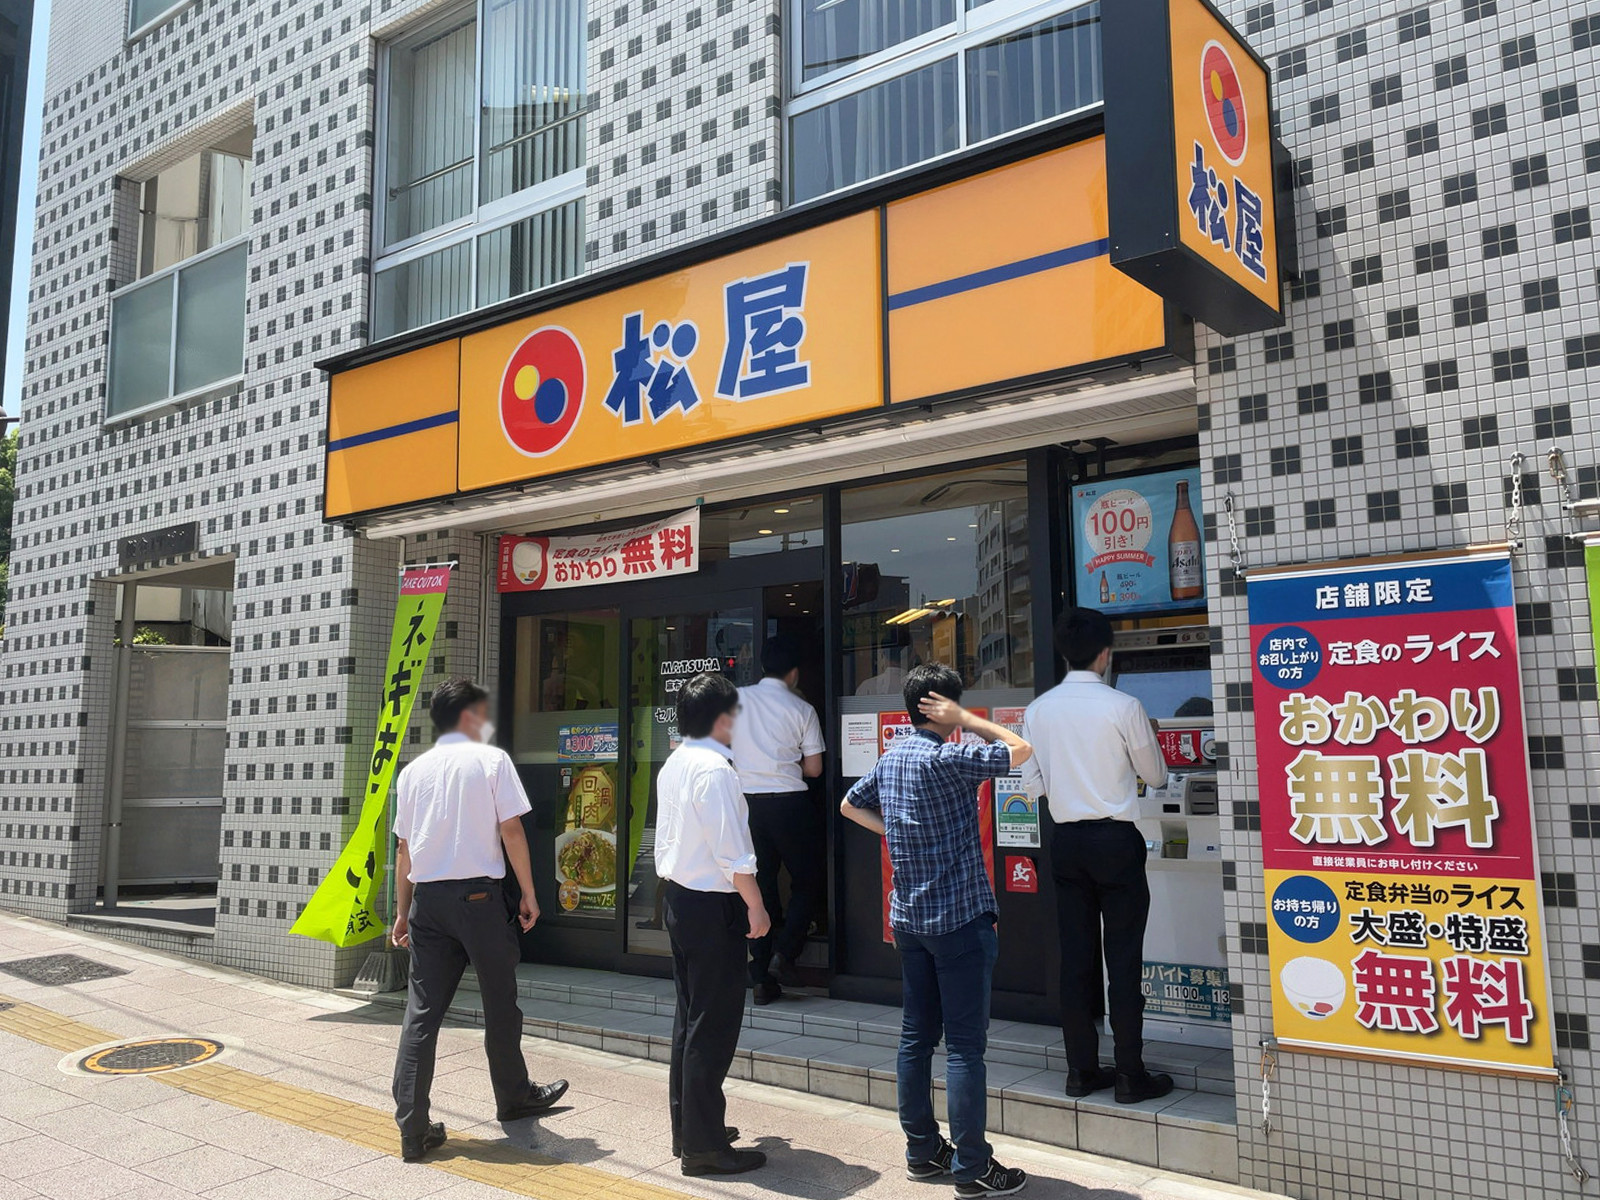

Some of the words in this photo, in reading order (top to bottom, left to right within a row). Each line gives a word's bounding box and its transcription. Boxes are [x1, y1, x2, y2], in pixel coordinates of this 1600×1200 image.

[1187, 139, 1267, 284] 松屋
[601, 260, 812, 428] 松屋
[1090, 508, 1149, 536] 100円
[552, 542, 620, 560] 定食のライス
[553, 556, 618, 583] おかわり
[620, 525, 694, 575] 無料
[1095, 555, 1116, 565] HAPPY
[1116, 553, 1145, 561] SUMMER
[1316, 578, 1433, 610] 店舗限定
[1269, 637, 1308, 651] 店内で
[1327, 631, 1501, 666] 定食のライス
[1259, 651, 1319, 667] お召し上がり
[1278, 666, 1302, 680] の方
[665, 678, 686, 692] 麻布
[655, 707, 677, 723] セル
[1279, 687, 1499, 745] おかわり
[667, 726, 680, 735] SEL
[571, 735, 594, 752] 300
[1285, 748, 1499, 848] 無料
[1312, 855, 1479, 872] 直接従業員にお申し付けください
[1344, 880, 1525, 911] 定食弁当のライス
[1273, 897, 1337, 914] お持ち帰り
[1294, 915, 1319, 929] の方
[1349, 907, 1529, 955] 大盛・特盛
[1352, 947, 1533, 1044] 無料
[992, 1172, 1007, 1188] N
